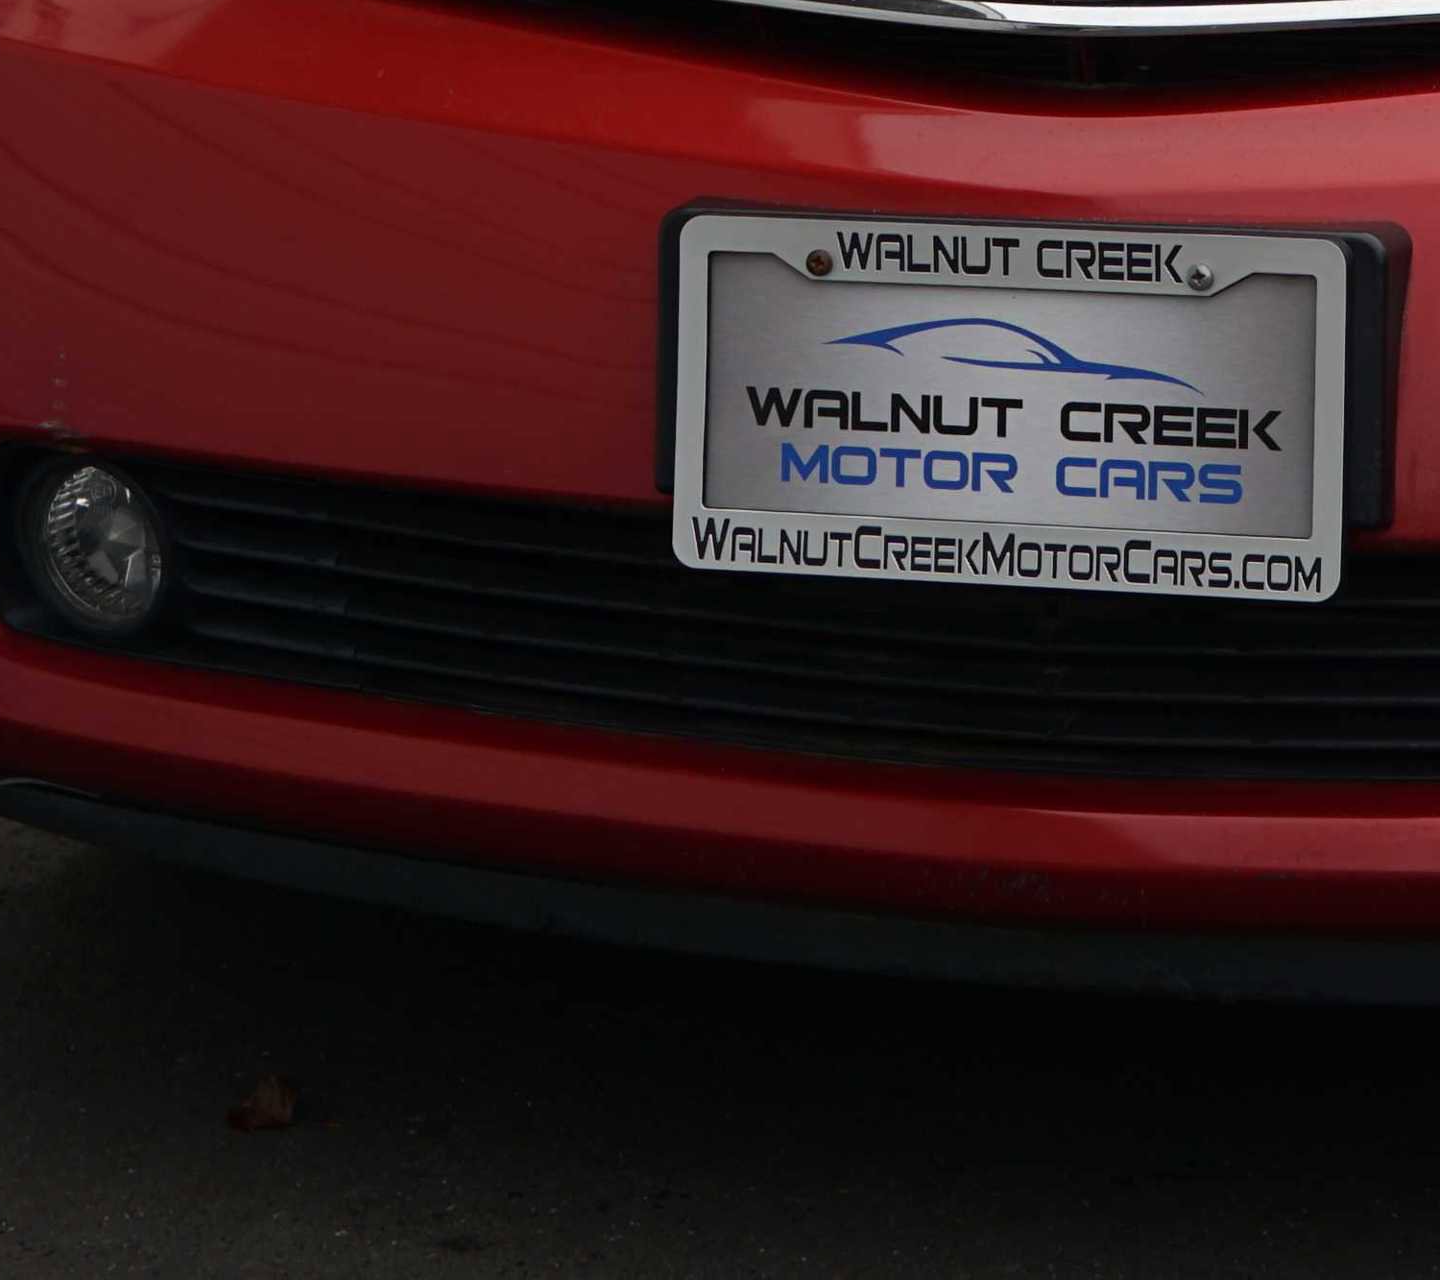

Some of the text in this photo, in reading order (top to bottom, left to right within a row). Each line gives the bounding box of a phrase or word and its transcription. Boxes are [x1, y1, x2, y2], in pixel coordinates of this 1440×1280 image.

[836, 230, 1184, 285] WALNUT CREEK
[746, 385, 1284, 452] WALNUT CREEK
[780, 442, 1244, 506] MOTOR CARS
